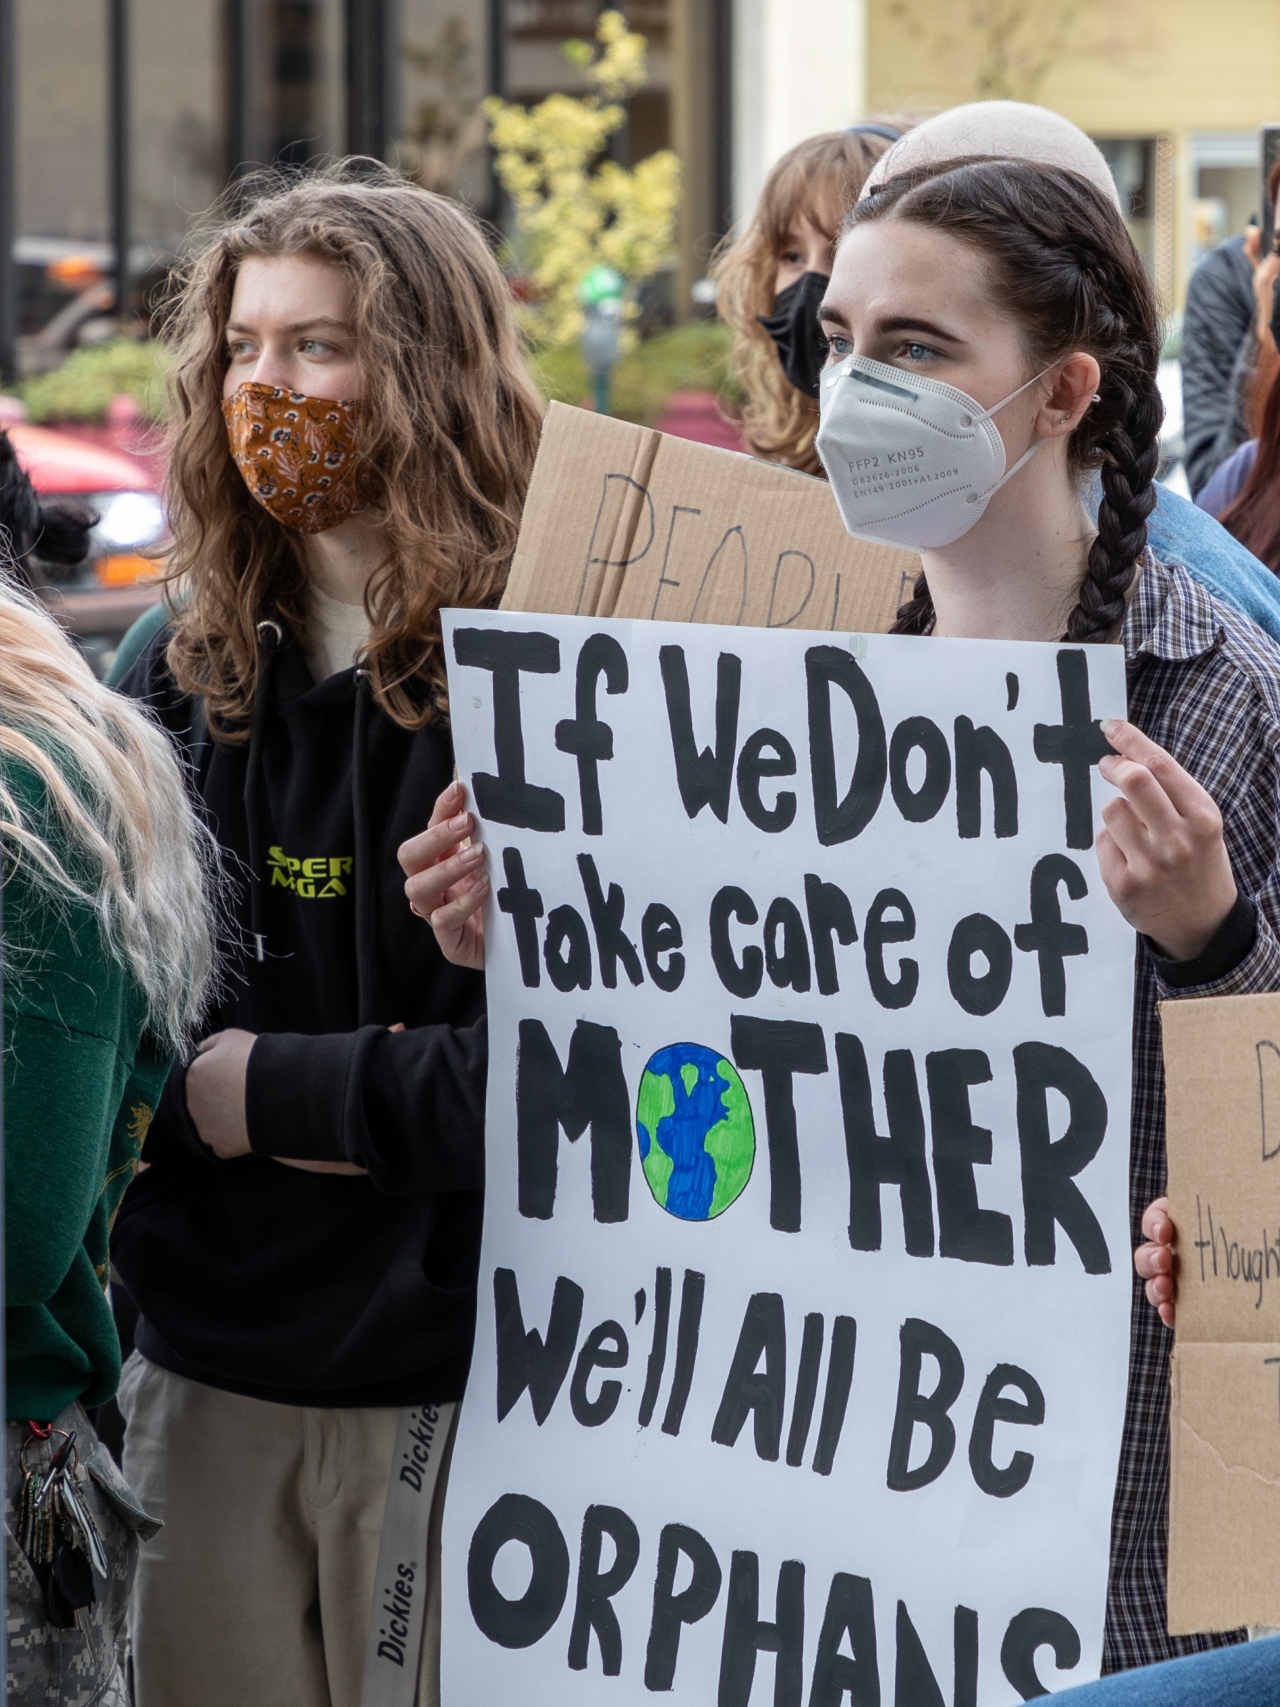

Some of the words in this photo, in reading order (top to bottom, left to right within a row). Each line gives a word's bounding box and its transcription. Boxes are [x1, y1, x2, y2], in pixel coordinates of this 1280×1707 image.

[848, 457, 880, 473] FFP2
[887, 446, 925, 465] KN95
[852, 464, 920, 486] GB2626-2006
[576, 473, 914, 631] PEOPL
[453, 627, 629, 835] If
[658, 644, 797, 834] We
[804, 644, 1119, 851] Don't
[266, 845, 353, 878] SPER
[497, 846, 687, 993] take
[709, 873, 920, 1011] care
[946, 853, 1090, 1018] of
[493, 1266, 706, 1437] We'll
[710, 1292, 857, 1477] All
[886, 1317, 1046, 1499] Be
[399, 1403, 442, 1493] Dickie
